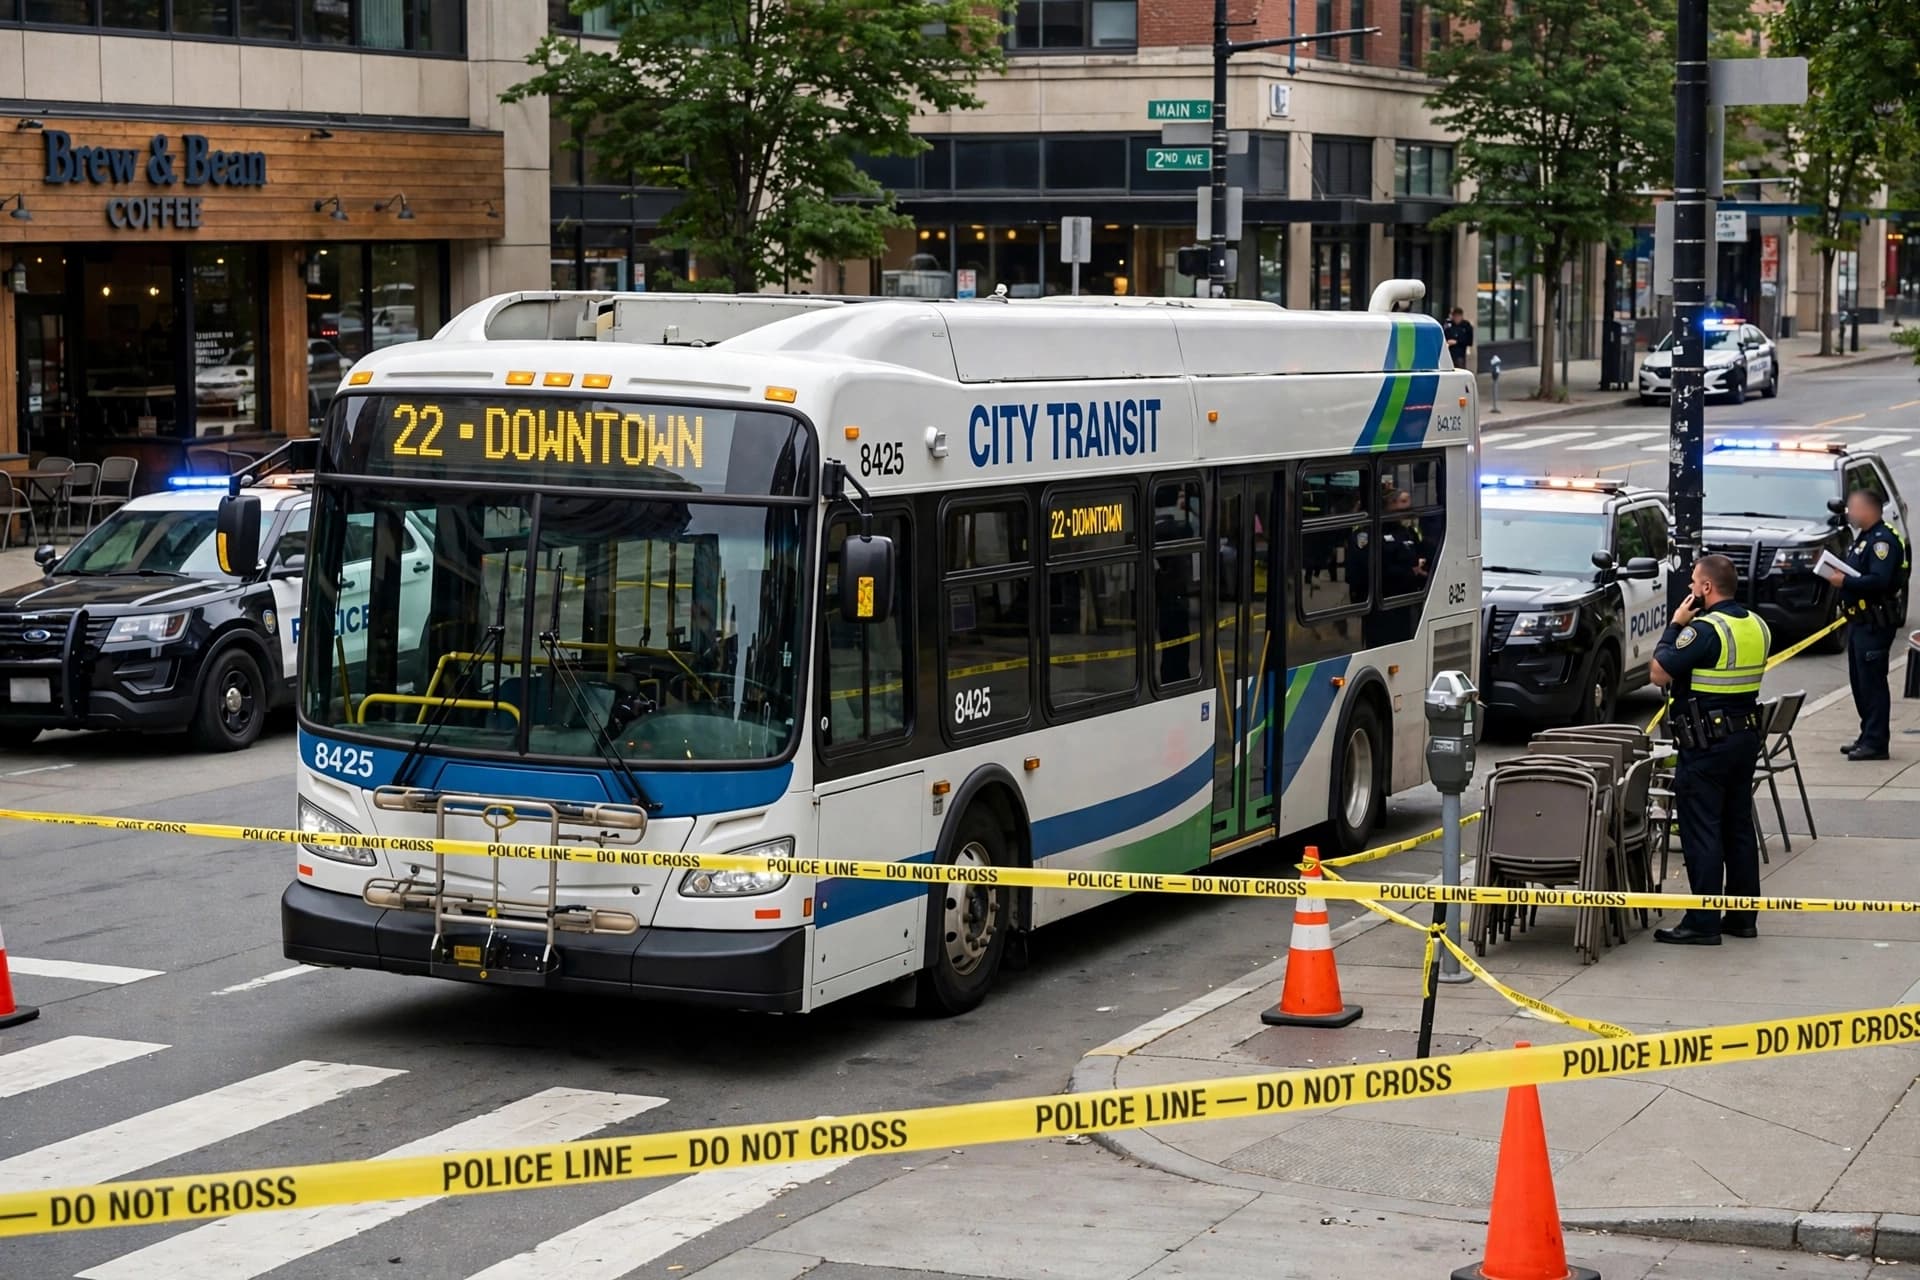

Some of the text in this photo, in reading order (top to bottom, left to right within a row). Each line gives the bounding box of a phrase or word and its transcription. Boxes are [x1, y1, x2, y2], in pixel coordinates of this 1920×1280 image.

[1156, 103, 1208, 118] MAIN ST
[42, 130, 267, 186] Brew & Bean
[1154, 152, 1204, 168] 2ND AVE
[107, 197, 203, 229] COFFEE
[394, 404, 444, 456] 22
[485, 408, 703, 468] DOWNTOWN
[968, 398, 1161, 468] CITY TRANSIT
[860, 442, 904, 477] 8425
[1052, 510, 1064, 538] 22
[1072, 504, 1122, 536] DOWNTOWN
[1630, 604, 1666, 640] POLICE
[954, 686, 991, 724] 8425
[315, 742, 374, 778] 8425
[242, 828, 286, 841] POLICE
[290, 832, 318, 844] LINE
[340, 836, 357, 846] DO
[362, 837, 388, 848] NOT
[391, 838, 434, 851] CROSS
[488, 844, 536, 858] POLICE
[542, 848, 572, 860] LINE
[597, 851, 615, 863] DO
[621, 852, 649, 864] NOT
[653, 854, 700, 868] CROSS
[767, 858, 820, 874] POLICE
[826, 862, 858, 876] LINE
[887, 864, 906, 878] DO
[912, 866, 942, 880] NOT
[947, 868, 998, 882] CROSS
[1068, 872, 1122, 888] POLICE
[1129, 875, 1163, 890] LINE
[1192, 878, 1212, 892] DO
[1219, 879, 1250, 894] NOT
[1255, 880, 1306, 896] CROSS
[1380, 884, 1436, 900] POLICE
[1442, 888, 1478, 901] LINE
[1508, 890, 1528, 903] DO
[1536, 891, 1567, 904] NOT
[1572, 892, 1626, 906] CROSS
[1702, 896, 1761, 908] POLICE
[1562, 1042, 1650, 1077] POLICE
[1659, 1035, 1712, 1066] LINE
[1756, 1026, 1789, 1054] DO
[1797, 1020, 1843, 1050] NOT
[1036, 1096, 1134, 1132] POLICE
[1146, 1088, 1206, 1122] LINE
[1256, 1080, 1294, 1110] DO
[1304, 1073, 1355, 1104] NOT
[1366, 1064, 1452, 1098] CROSS
[443, 1152, 552, 1191] POLICE
[565, 1145, 632, 1180] LINE
[690, 1136, 730, 1167] DO
[742, 1129, 800, 1162] NOT
[810, 1119, 908, 1156] CROSS
[50, 1194, 96, 1226] DO
[110, 1186, 174, 1222] NOT
[188, 1176, 297, 1214] CROSS
